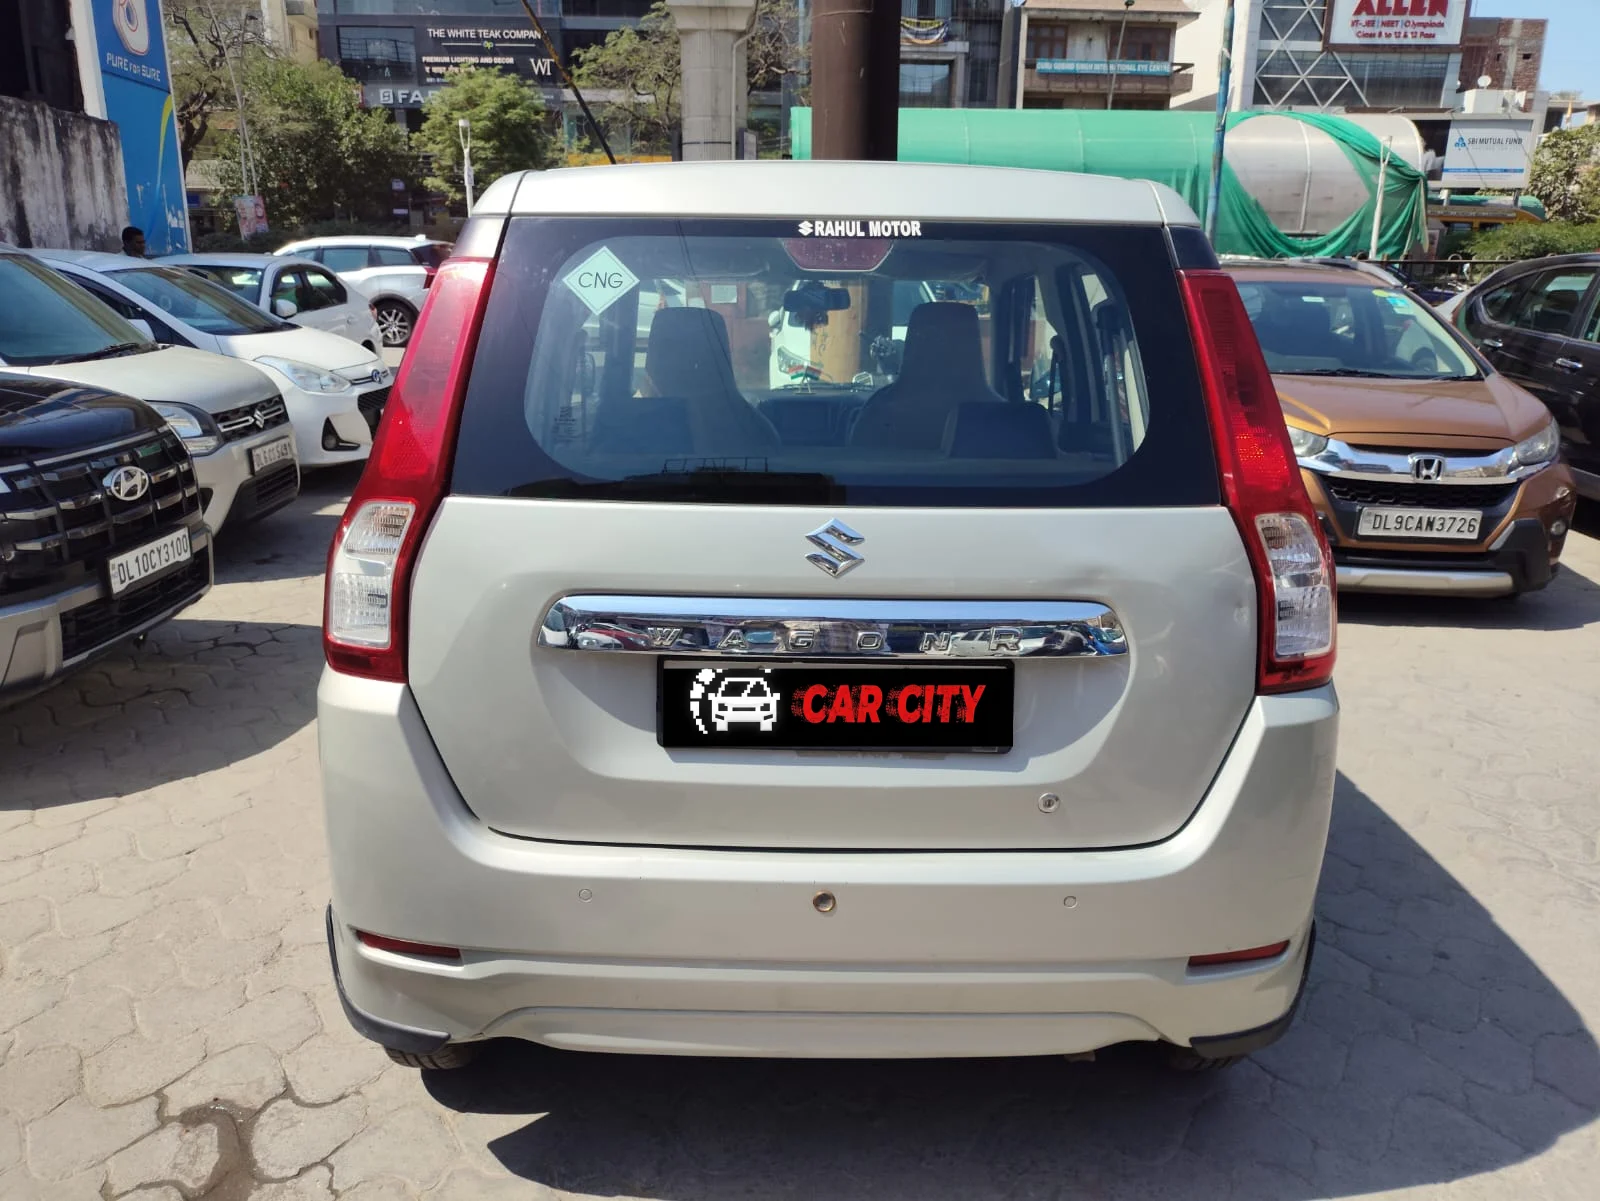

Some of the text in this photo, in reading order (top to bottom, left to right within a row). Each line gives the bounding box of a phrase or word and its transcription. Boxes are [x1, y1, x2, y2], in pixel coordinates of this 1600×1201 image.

[1380, 20, 1400, 28] NEET
[427, 28, 548, 40] THE WHITE TEAK COMPAN
[106, 52, 129, 71] PURE
[141, 64, 161, 82] SURE
[1467, 137, 1523, 145] SBI MUTUAL FUND
[814, 220, 922, 237] RAHUL MOTOR
[578, 271, 623, 289] CNG
[1371, 513, 1478, 533] DL9CAN3726
[117, 534, 189, 585] DL10CY3100
